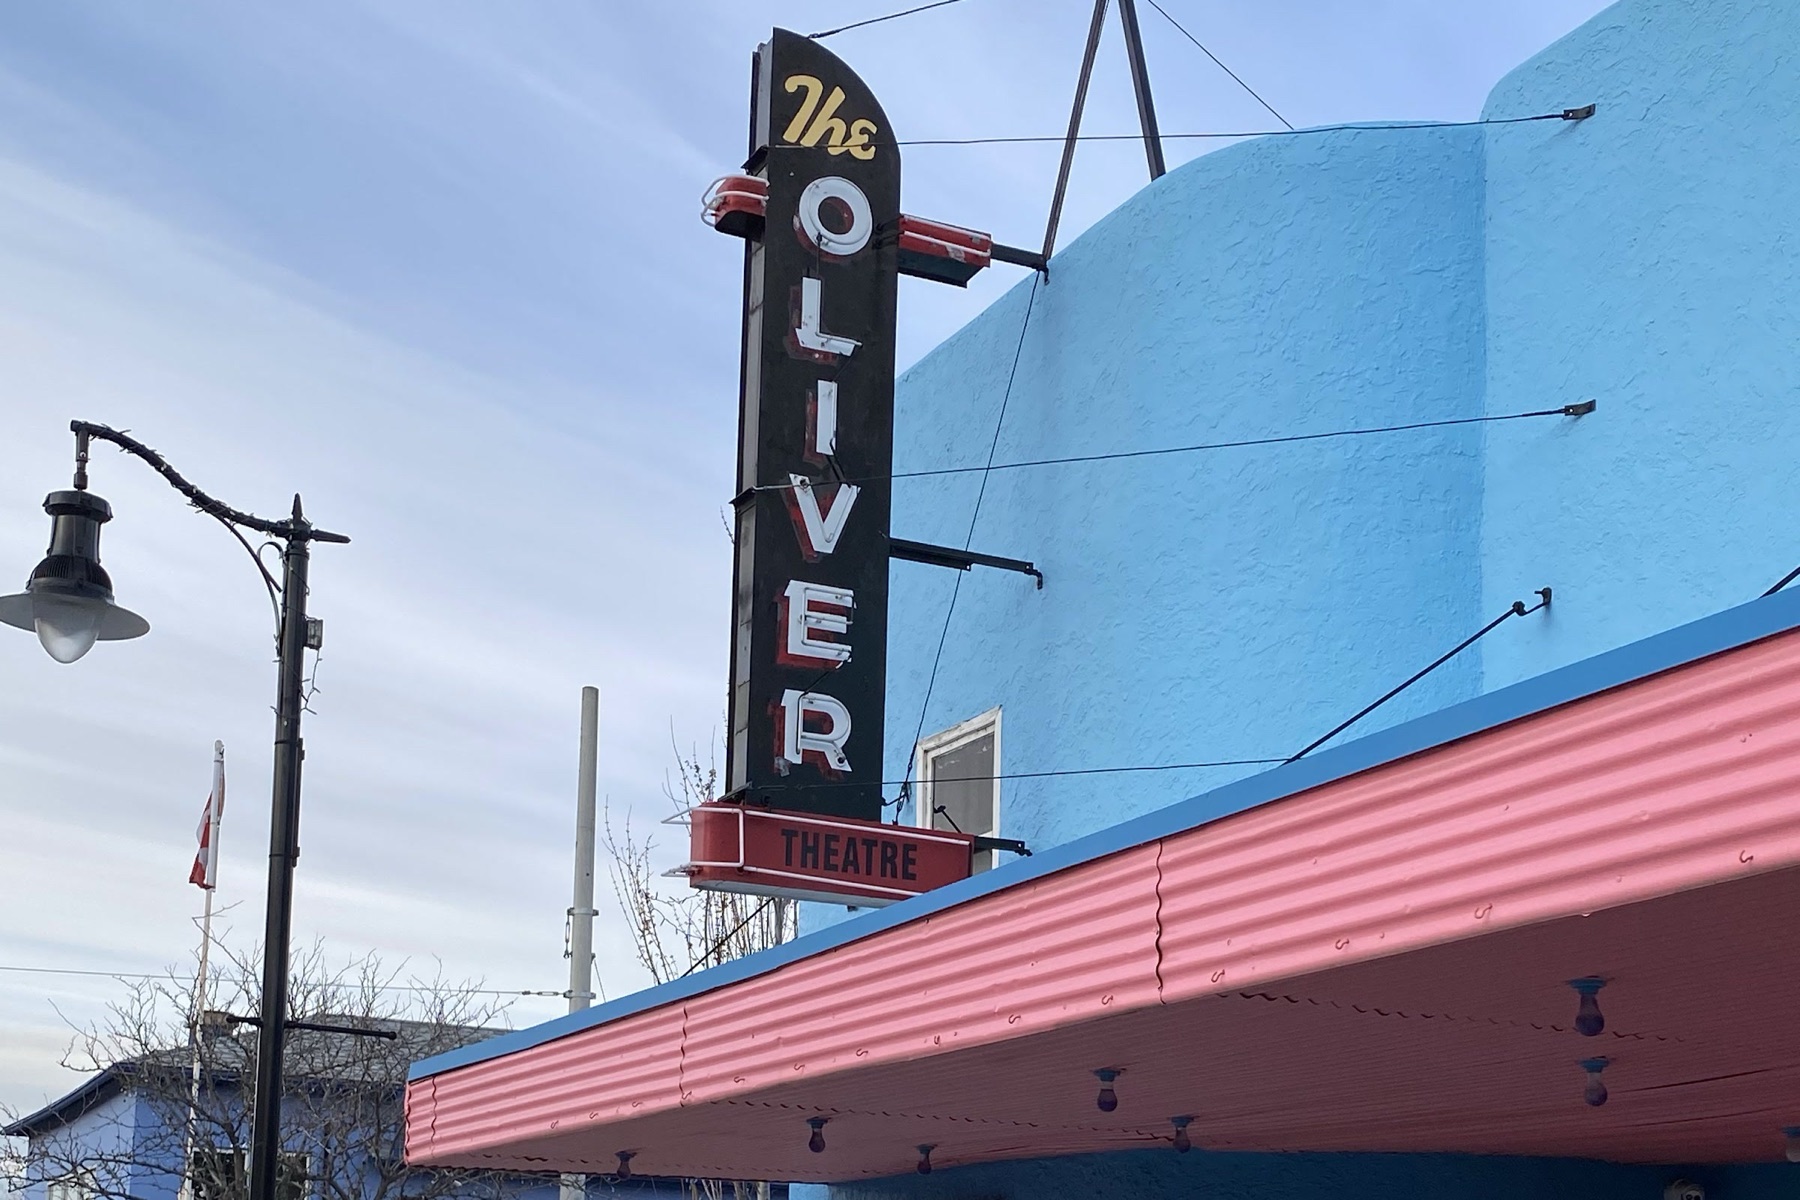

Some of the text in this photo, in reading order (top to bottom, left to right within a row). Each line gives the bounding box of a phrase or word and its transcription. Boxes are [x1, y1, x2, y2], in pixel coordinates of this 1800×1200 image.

[784, 75, 877, 160] The
[780, 176, 872, 772] OLIVER
[782, 829, 917, 880] THEATRE
